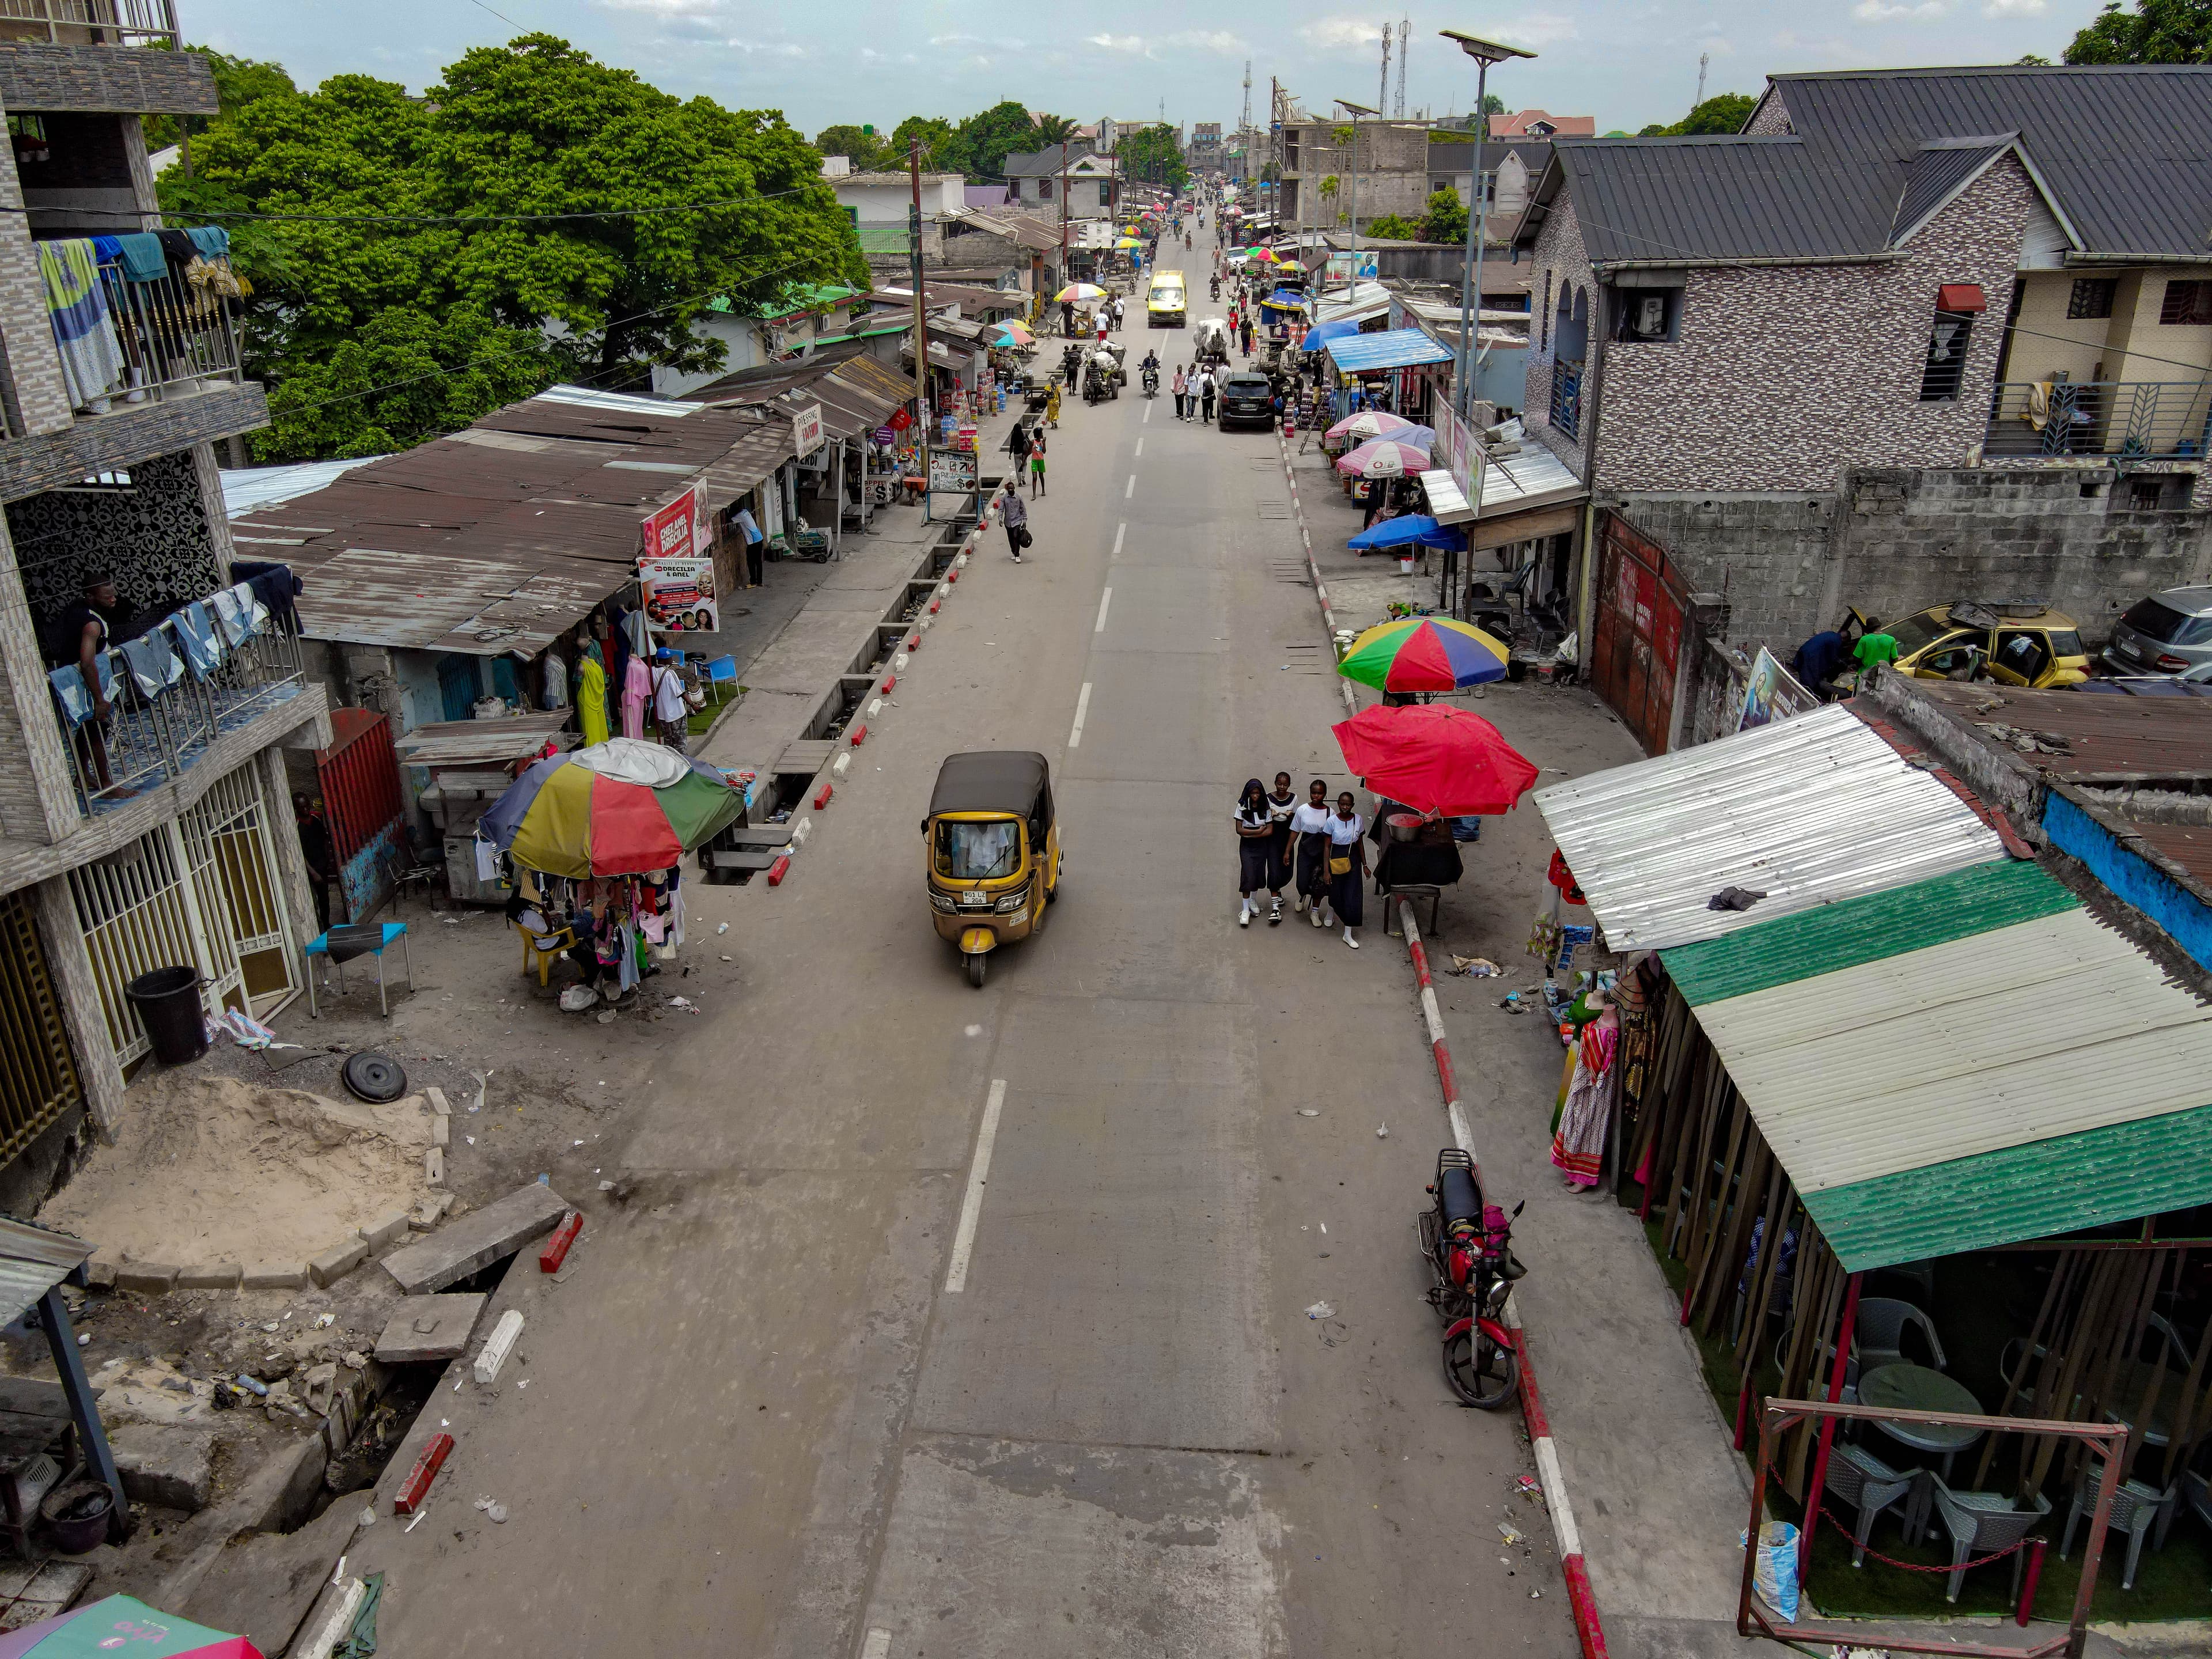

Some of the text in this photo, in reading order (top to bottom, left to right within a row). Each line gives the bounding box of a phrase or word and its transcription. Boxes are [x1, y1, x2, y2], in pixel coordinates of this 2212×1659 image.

[798, 410, 817, 427] PRESSING
[660, 513, 687, 540] CHEZ ANEL
[661, 524, 688, 554] DRECILIA
